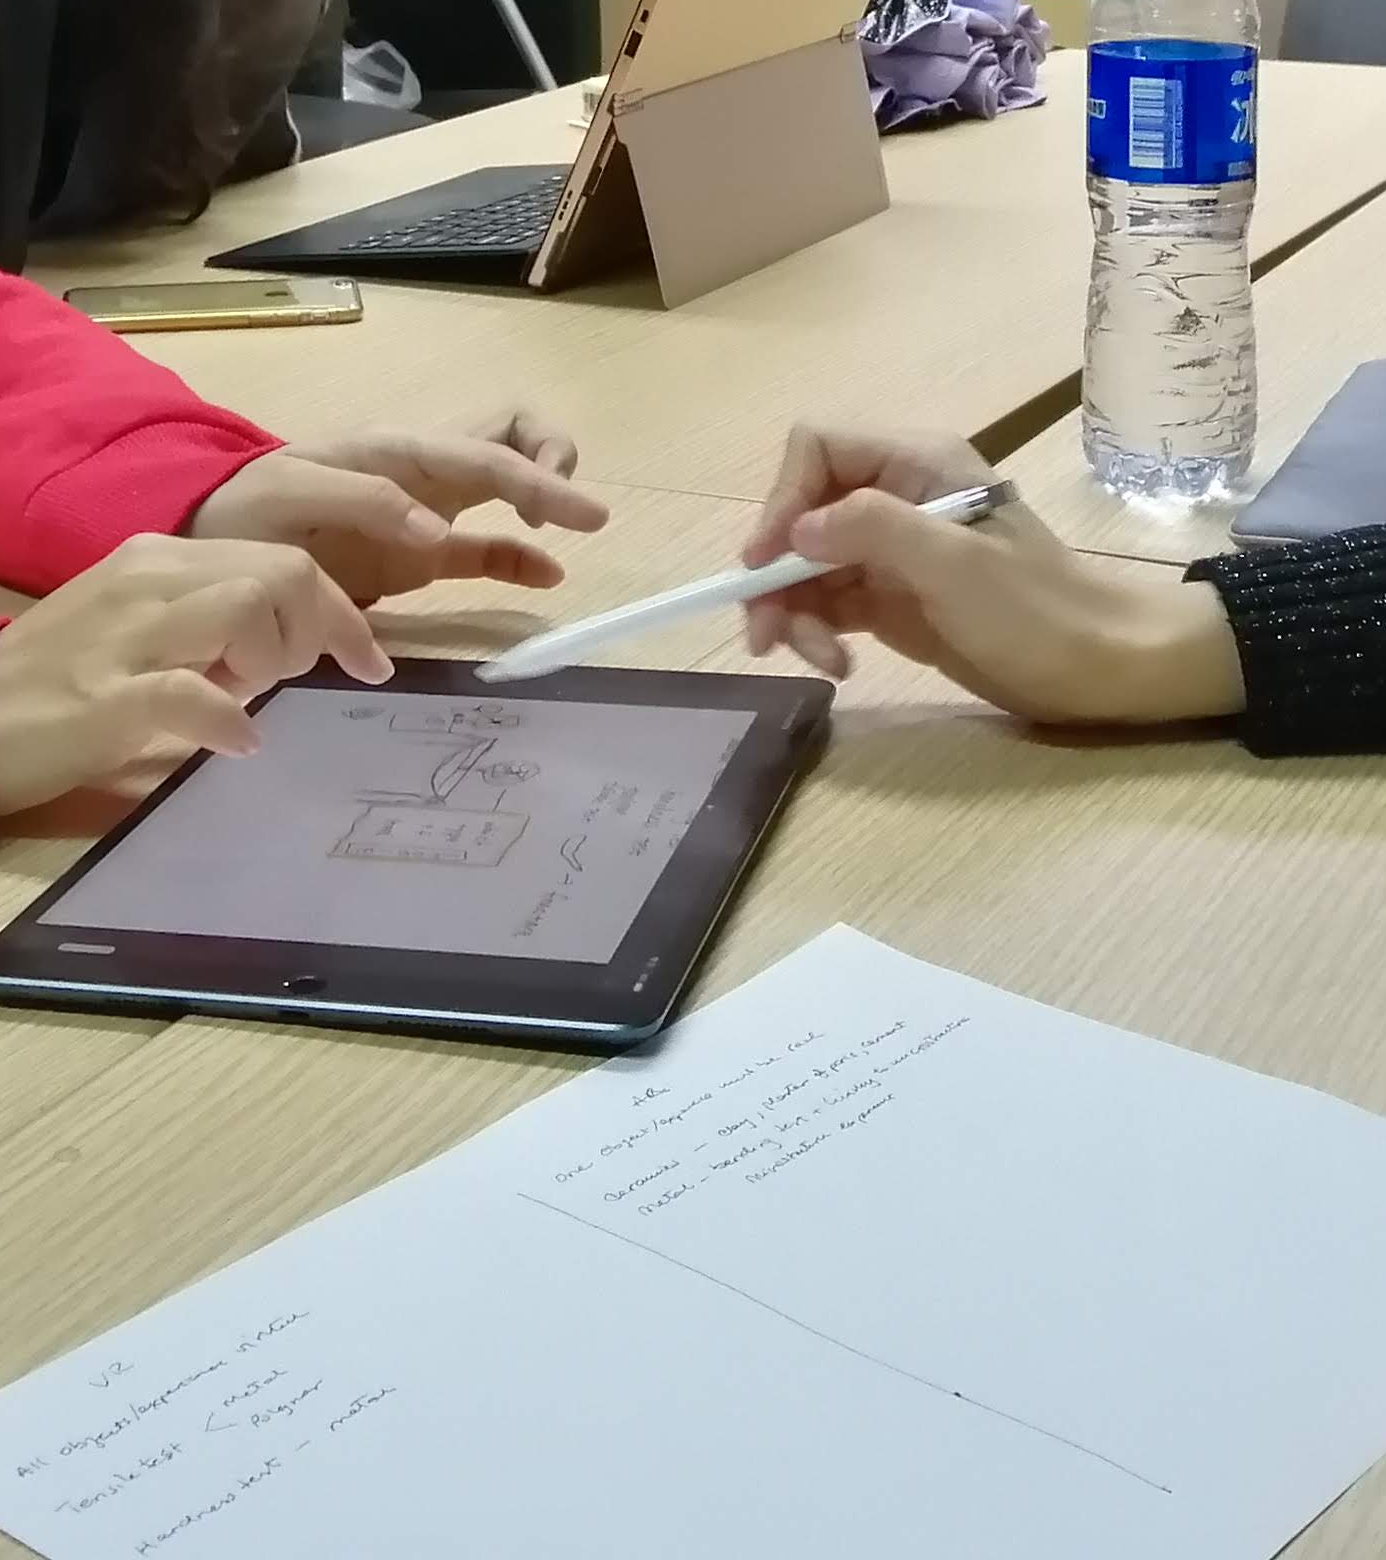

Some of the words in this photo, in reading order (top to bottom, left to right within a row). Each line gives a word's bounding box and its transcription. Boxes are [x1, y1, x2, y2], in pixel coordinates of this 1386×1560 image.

[88, 1361, 135, 1389] VR
[16, 1456, 52, 1478] All
[54, 1472, 142, 1514] Tensile
[139, 1442, 183, 1469] test
[134, 1491, 237, 1556] Hardness
